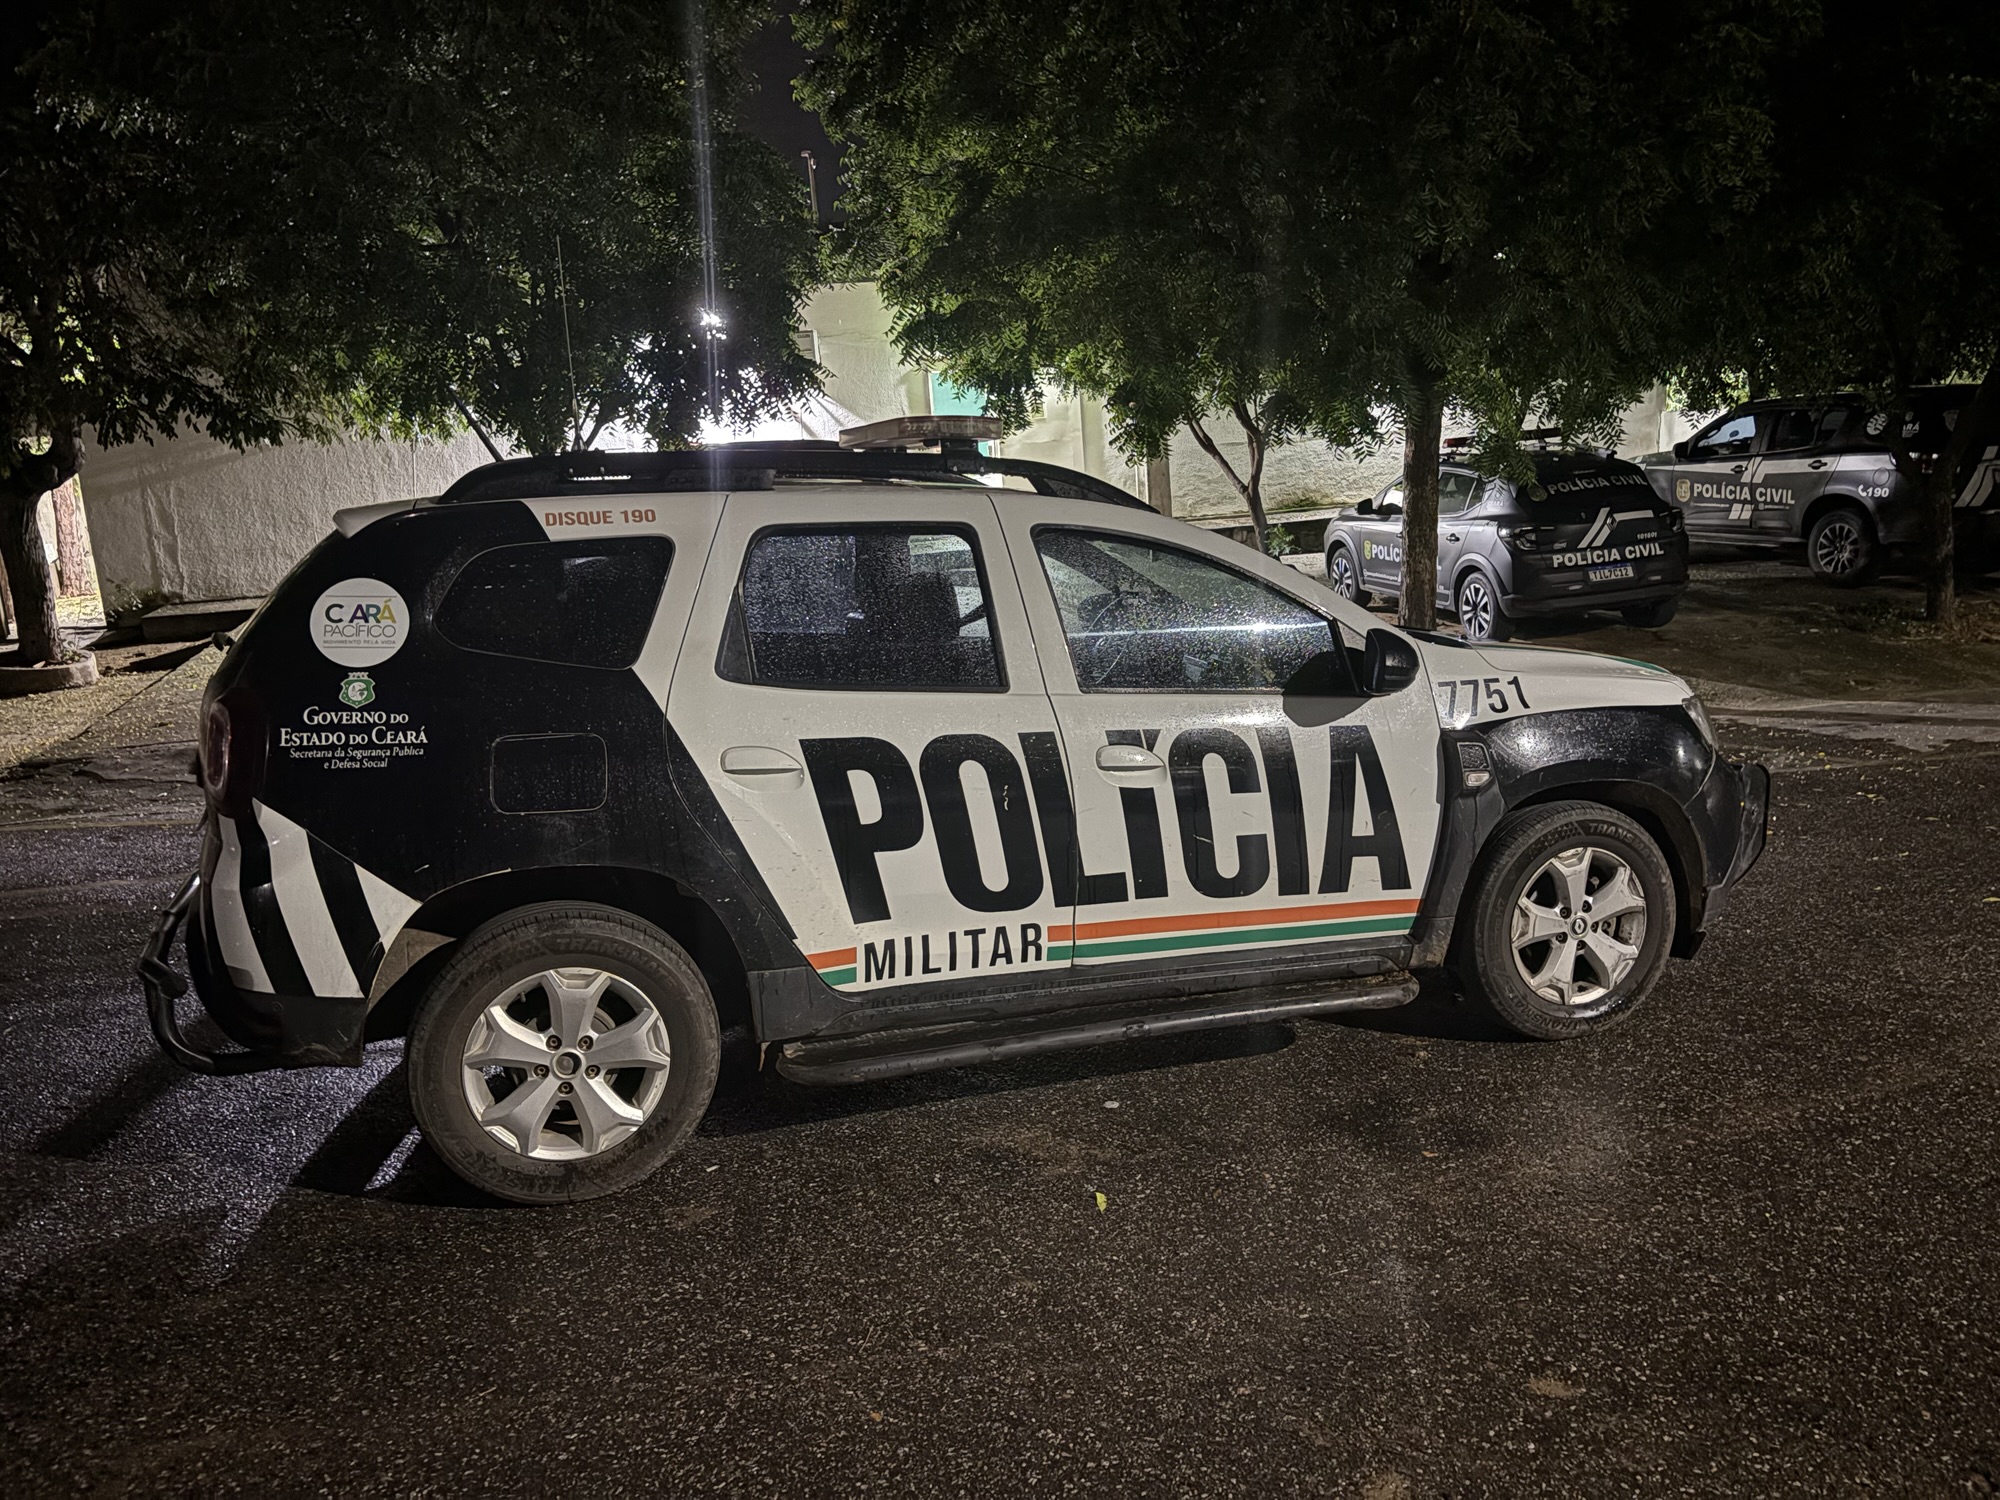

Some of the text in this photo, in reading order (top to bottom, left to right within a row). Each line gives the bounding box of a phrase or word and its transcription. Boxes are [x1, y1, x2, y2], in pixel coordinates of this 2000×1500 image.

[1547, 473, 1648, 495] POLÍCIA CIVIL
[1693, 482, 1796, 505] POLÍCIA CIVIL
[1866, 487, 1890, 498] 190
[545, 509, 657, 526] DISQUE 190
[1371, 543, 1402, 563] POLÍC
[1552, 542, 1665, 569] POLÍCIA CIVIL
[323, 622, 397, 638] PACÍFICO
[1438, 675, 1531, 719] 7751
[303, 706, 387, 725] GOVERNO
[279, 728, 346, 747] ESTADO
[371, 725, 428, 744] CEARÁ
[289, 748, 332, 758] Secretaria
[334, 747, 345, 757] da
[347, 747, 391, 760] Segurança
[323, 758, 388, 769] e Defesa Social
[798, 724, 1412, 925] POLÍCIA
[864, 923, 1042, 983] MILITAR
